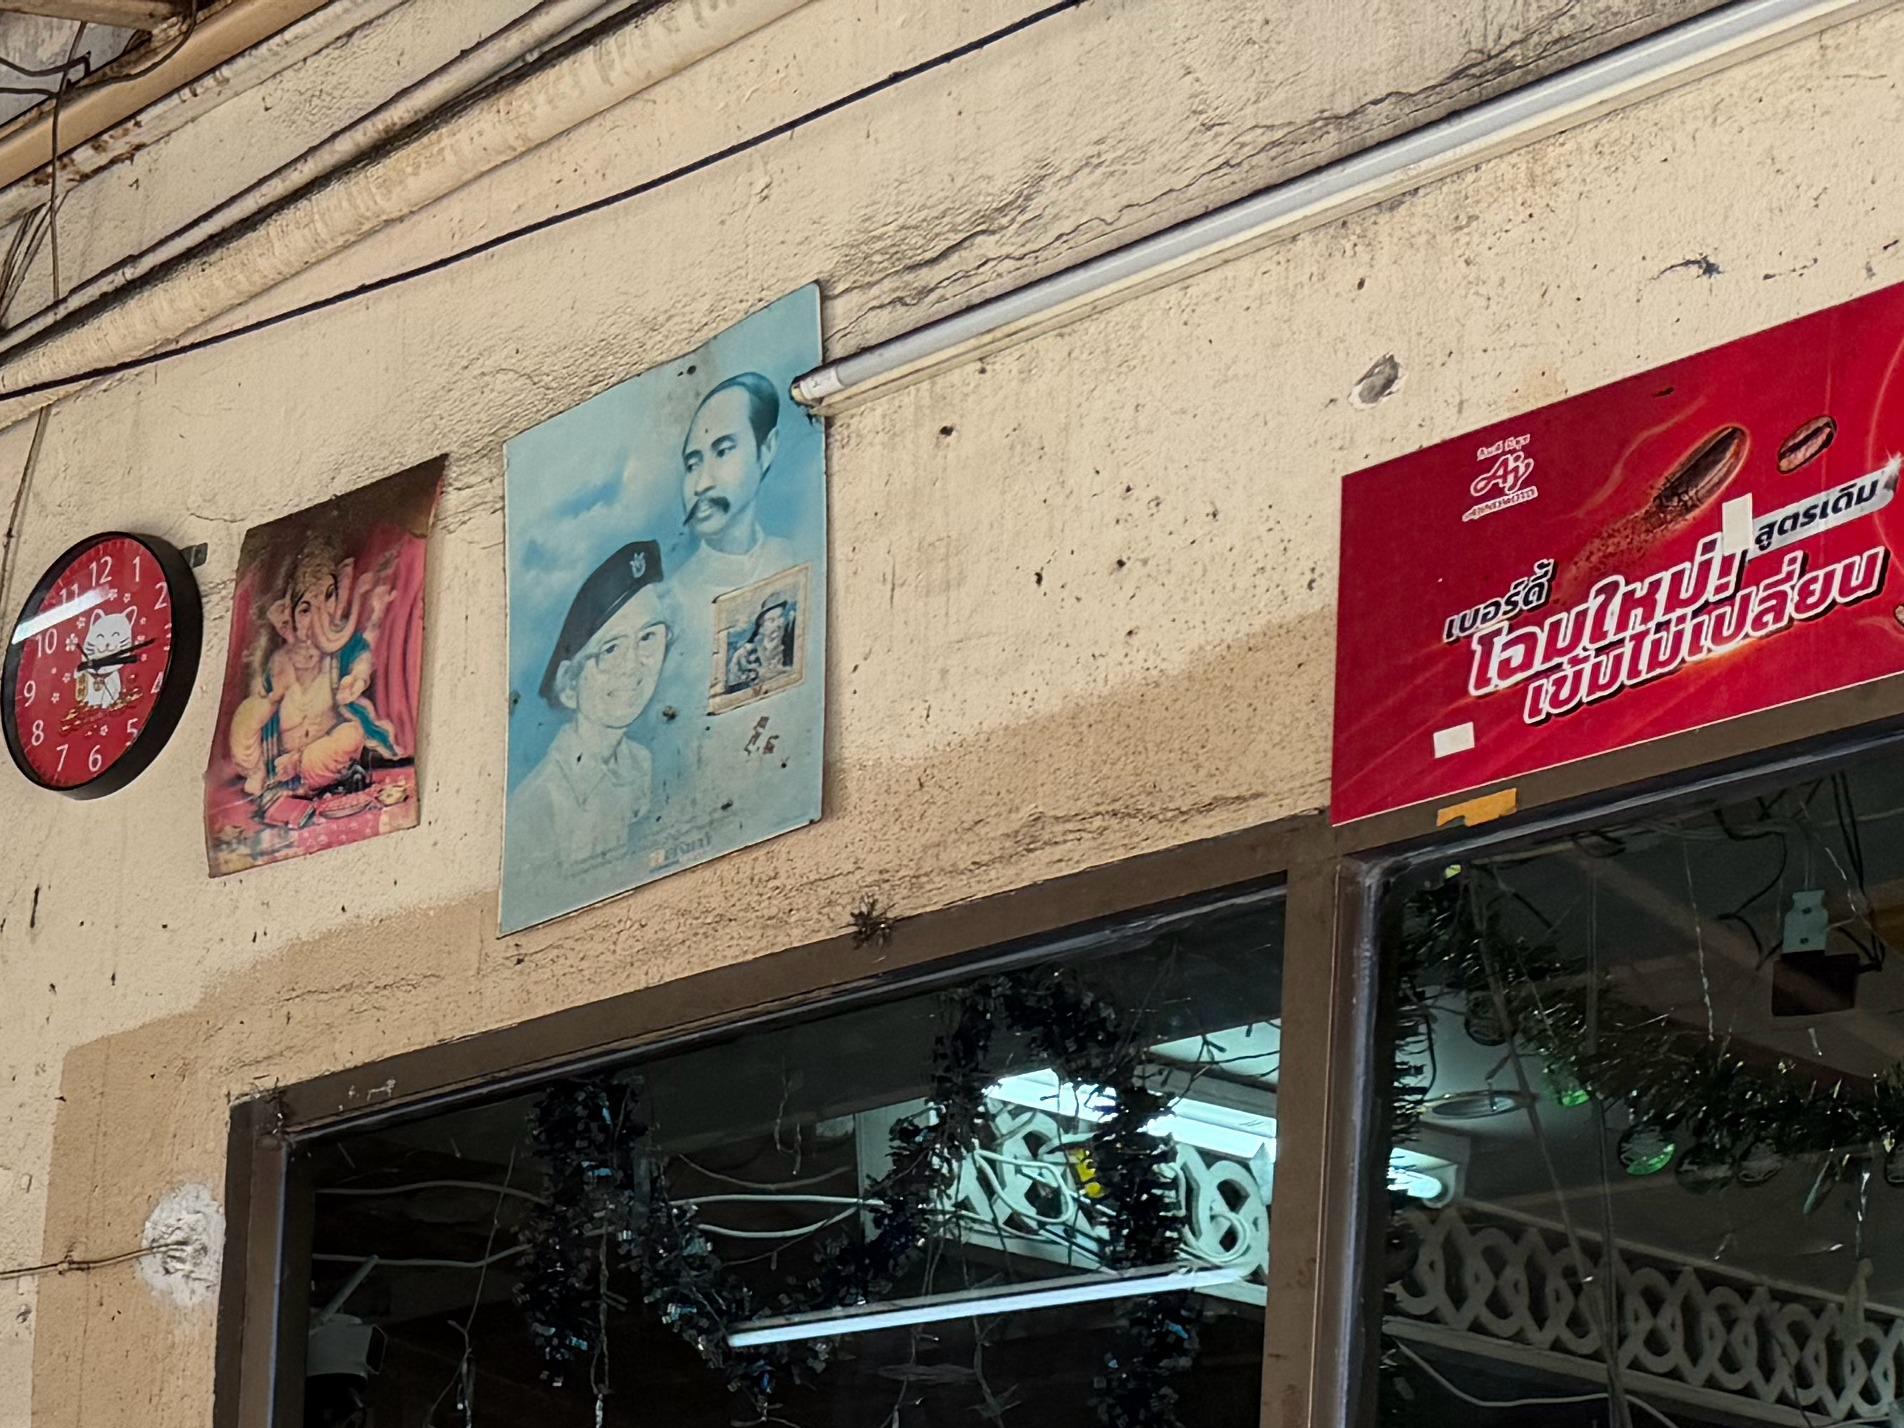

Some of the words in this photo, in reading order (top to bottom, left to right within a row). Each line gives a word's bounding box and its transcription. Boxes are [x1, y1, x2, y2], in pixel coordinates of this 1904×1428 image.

[1753, 475, 1880, 551] สูตรเดิม
[89, 556, 112, 586] 12
[133, 557, 140, 582] 1
[154, 582, 168, 610] 2
[1444, 559, 1556, 644] เบอร์ดี้
[35, 628, 57, 658] 10
[1524, 547, 1887, 725] เข้มไม่เปลี่ยน
[24, 680, 35, 707] 9
[32, 720, 44, 745] 8
[126, 718, 138, 739] 5
[56, 744, 68, 771] 7
[88, 745, 102, 771] 6
